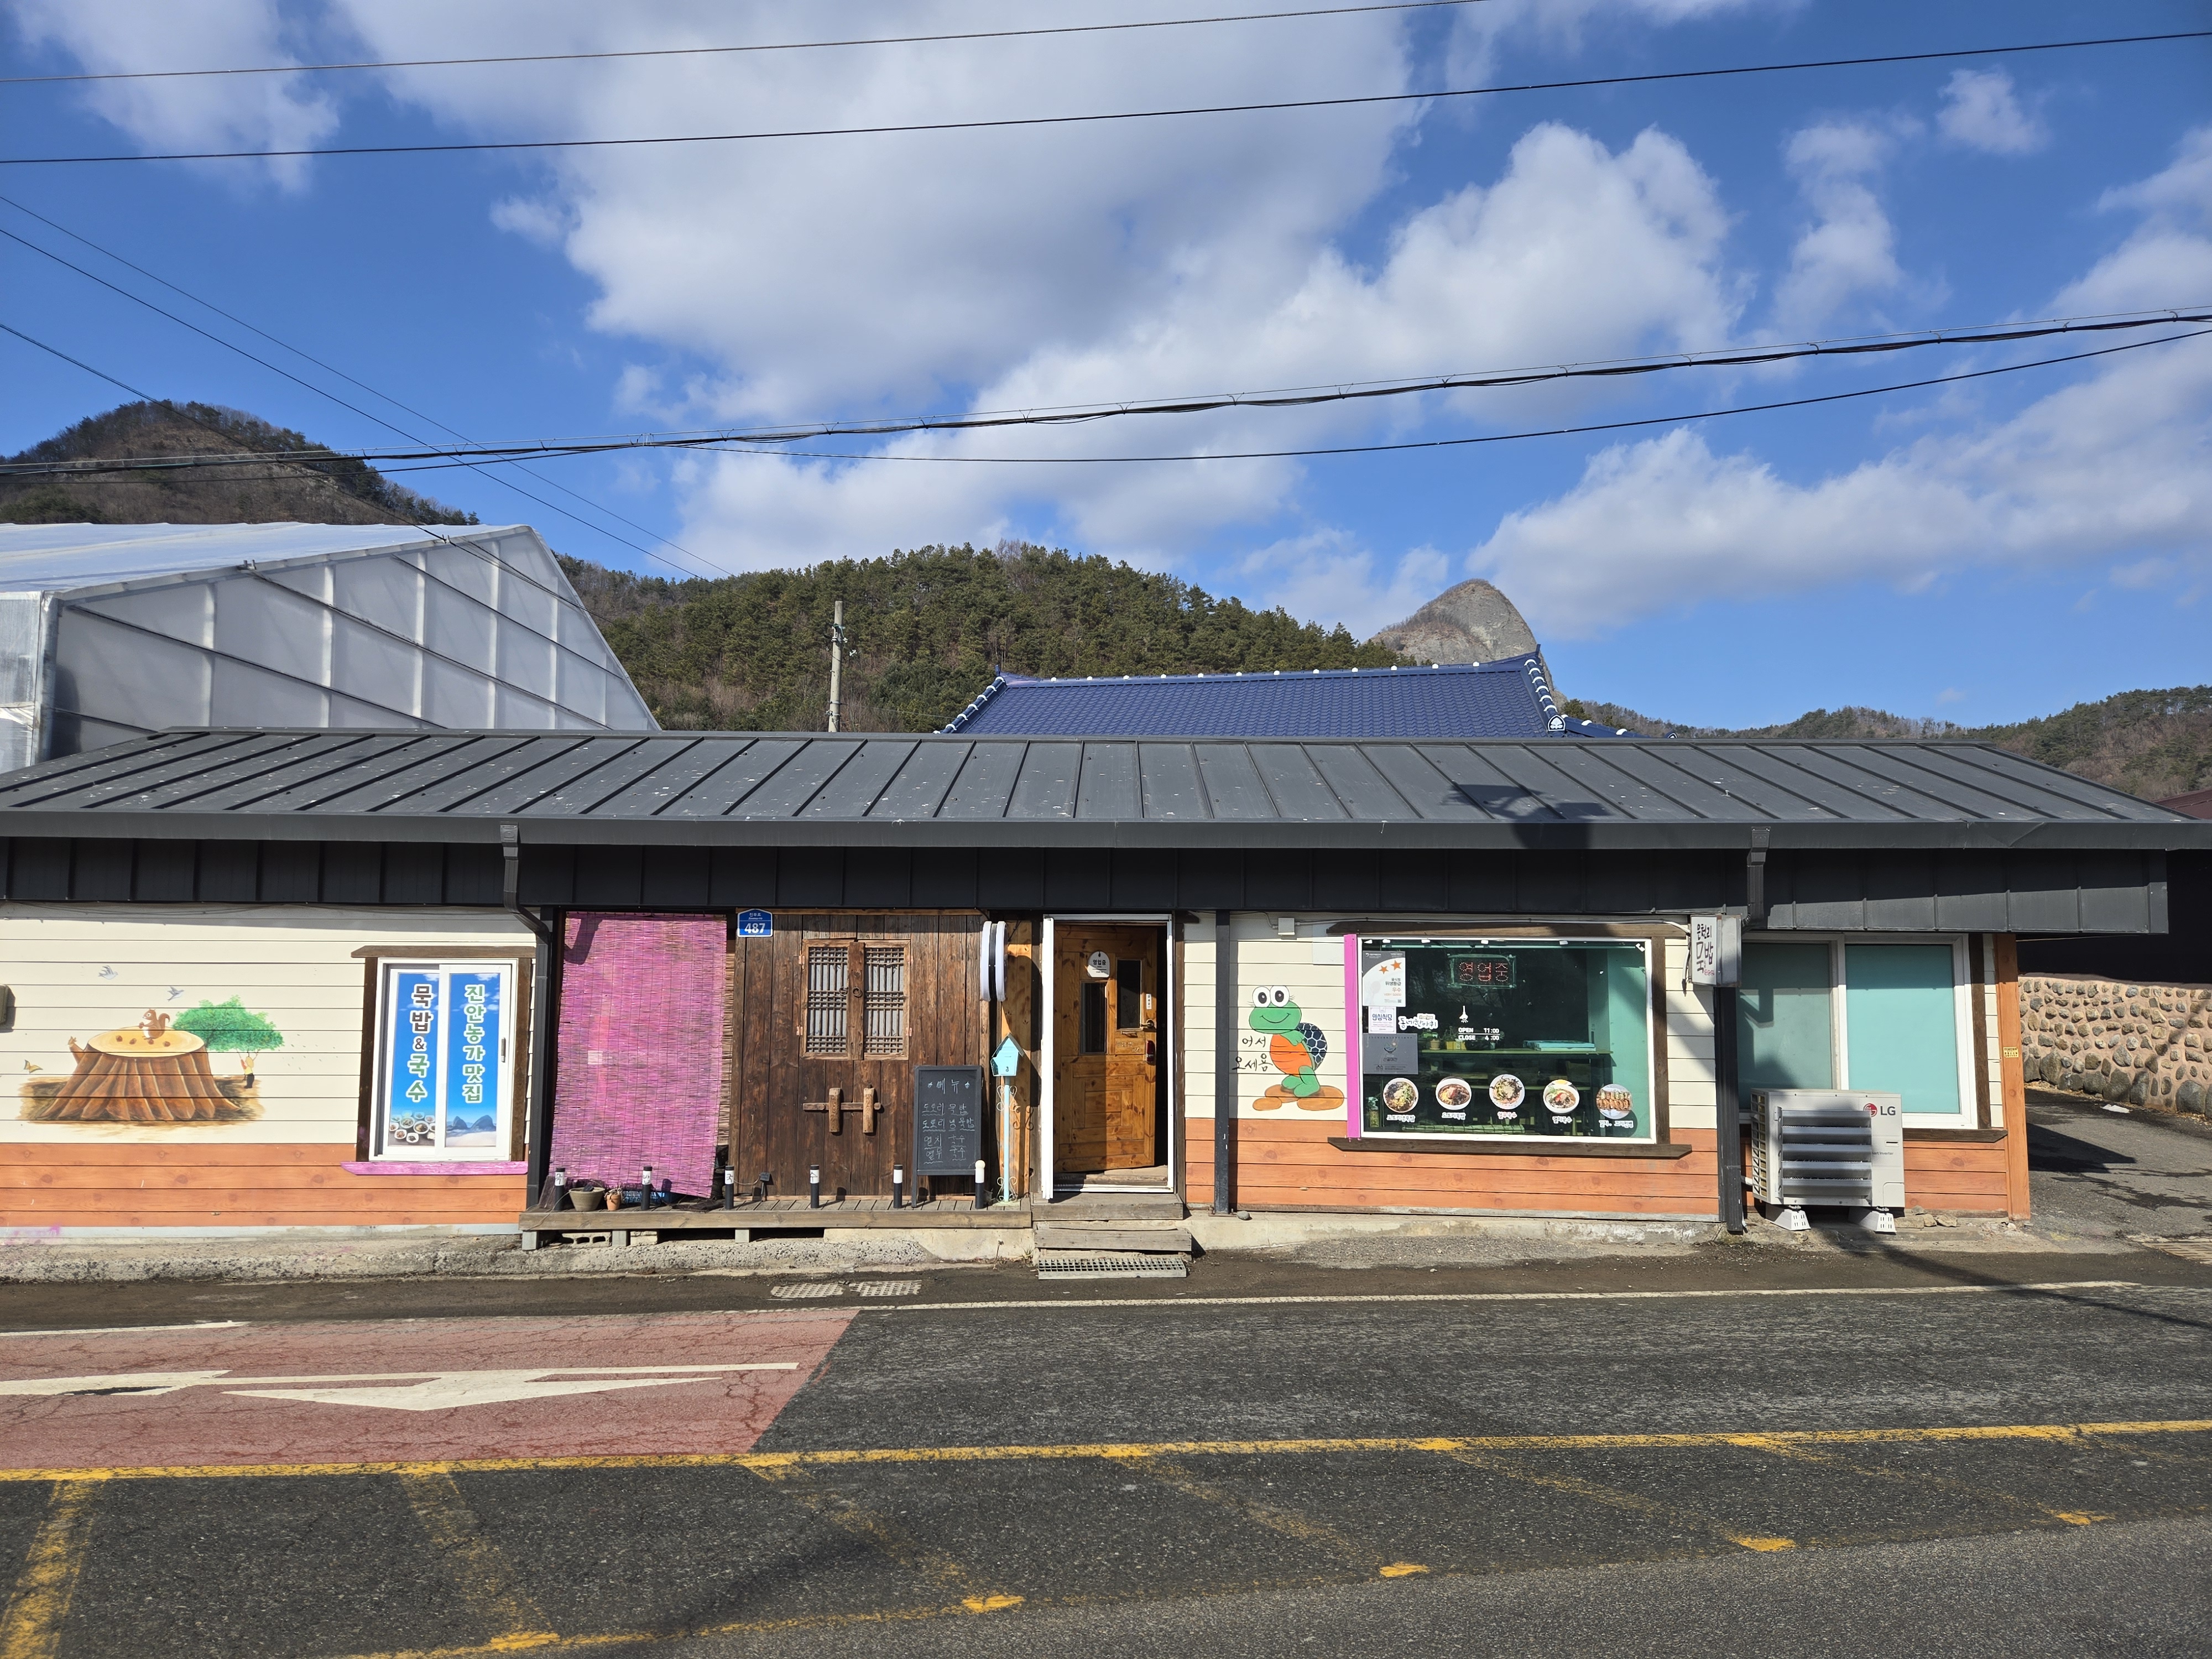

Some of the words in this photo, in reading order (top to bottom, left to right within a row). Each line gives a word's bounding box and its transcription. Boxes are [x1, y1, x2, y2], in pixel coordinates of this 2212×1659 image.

[744, 923, 765, 933] 487
[1697, 924, 1712, 941] 은천리
[1696, 941, 1714, 974] 묵밥
[1459, 962, 1509, 982] 영업중
[411, 985, 432, 1032] 묵밥
[415, 1037, 425, 1050] &
[1242, 1035, 1266, 1048] 어서
[407, 1055, 429, 1102] 국수
[922, 1103, 944, 1115] 도토리
[948, 1103, 968, 1115] 묵밥
[1880, 1106, 1896, 1115] LG
[922, 1118, 945, 1129] 도토리
[948, 1134, 966, 1144] 국수
[926, 1146, 942, 1160] 열무
[950, 1147, 966, 1159] 국수
